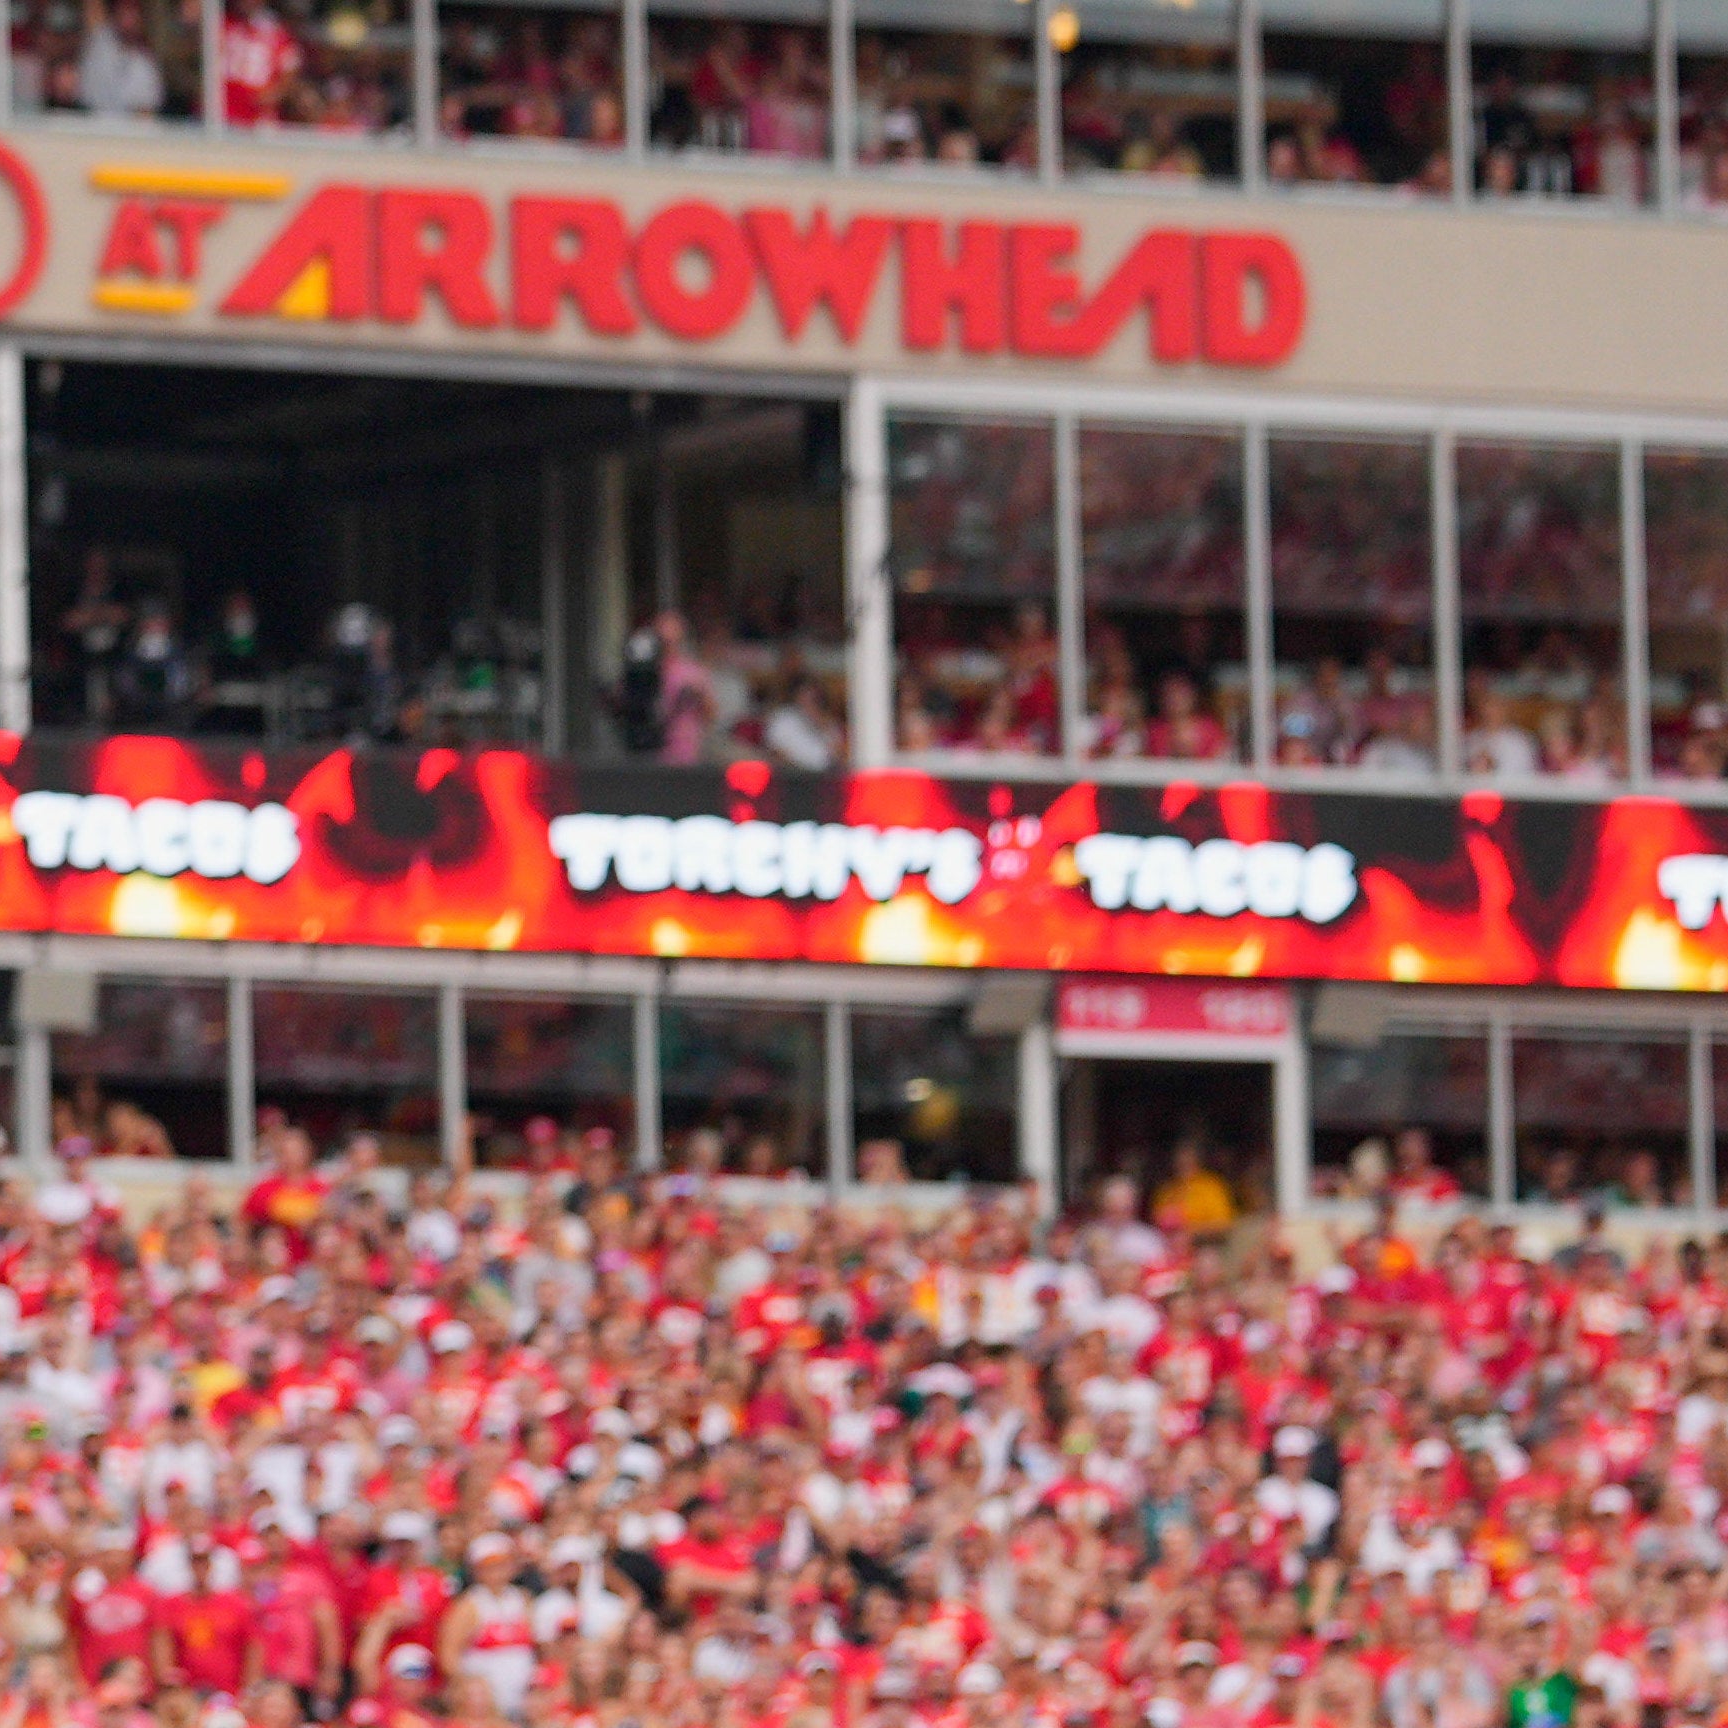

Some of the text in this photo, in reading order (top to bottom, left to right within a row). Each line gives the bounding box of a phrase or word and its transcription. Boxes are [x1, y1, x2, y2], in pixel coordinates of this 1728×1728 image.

[95, 198, 231, 284] AT
[217, 183, 1307, 368] ARROWHEAD
[11, 788, 303, 887] TACOS
[547, 812, 1360, 925] TORCHY'S TACOS
[1658, 853, 1728, 930] T
